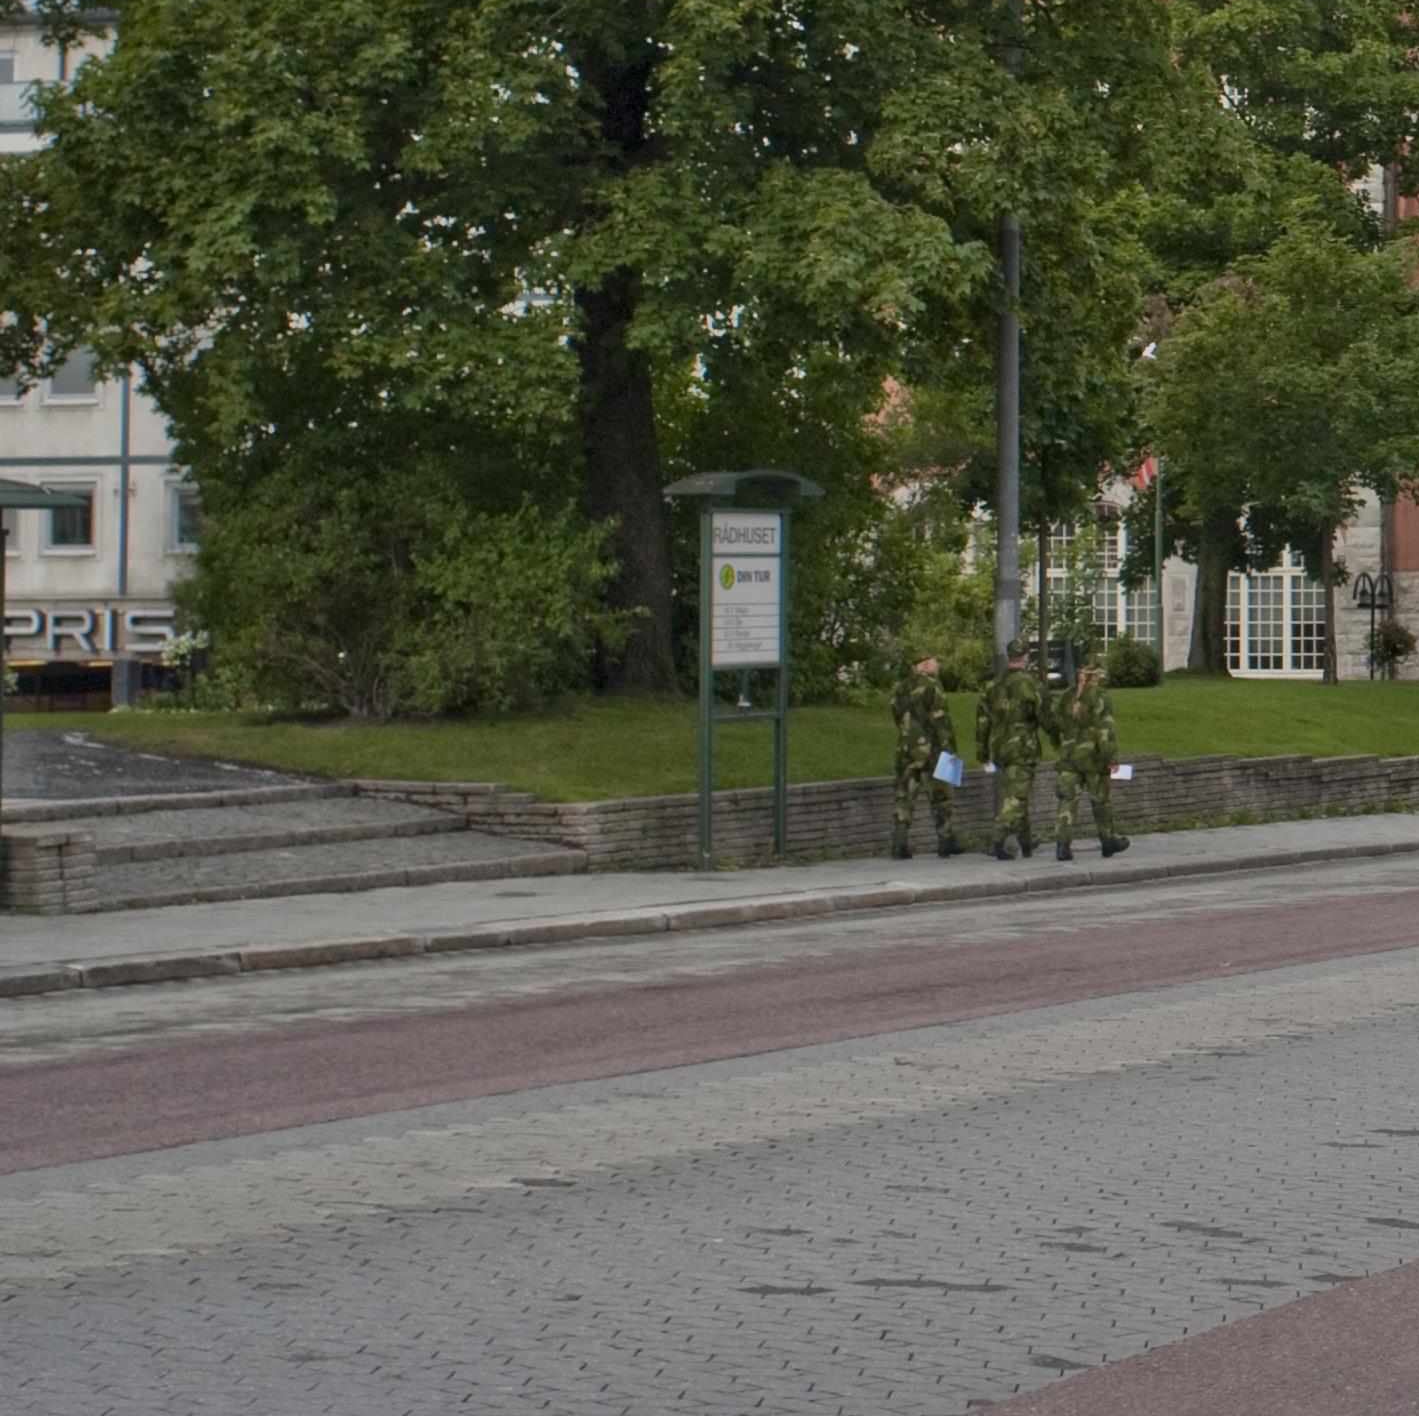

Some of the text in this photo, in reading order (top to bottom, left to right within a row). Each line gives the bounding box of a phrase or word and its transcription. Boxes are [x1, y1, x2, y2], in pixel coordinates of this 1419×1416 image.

[713, 523, 777, 544] RÅDHUSET
[736, 570, 770, 582] DIN TUR
